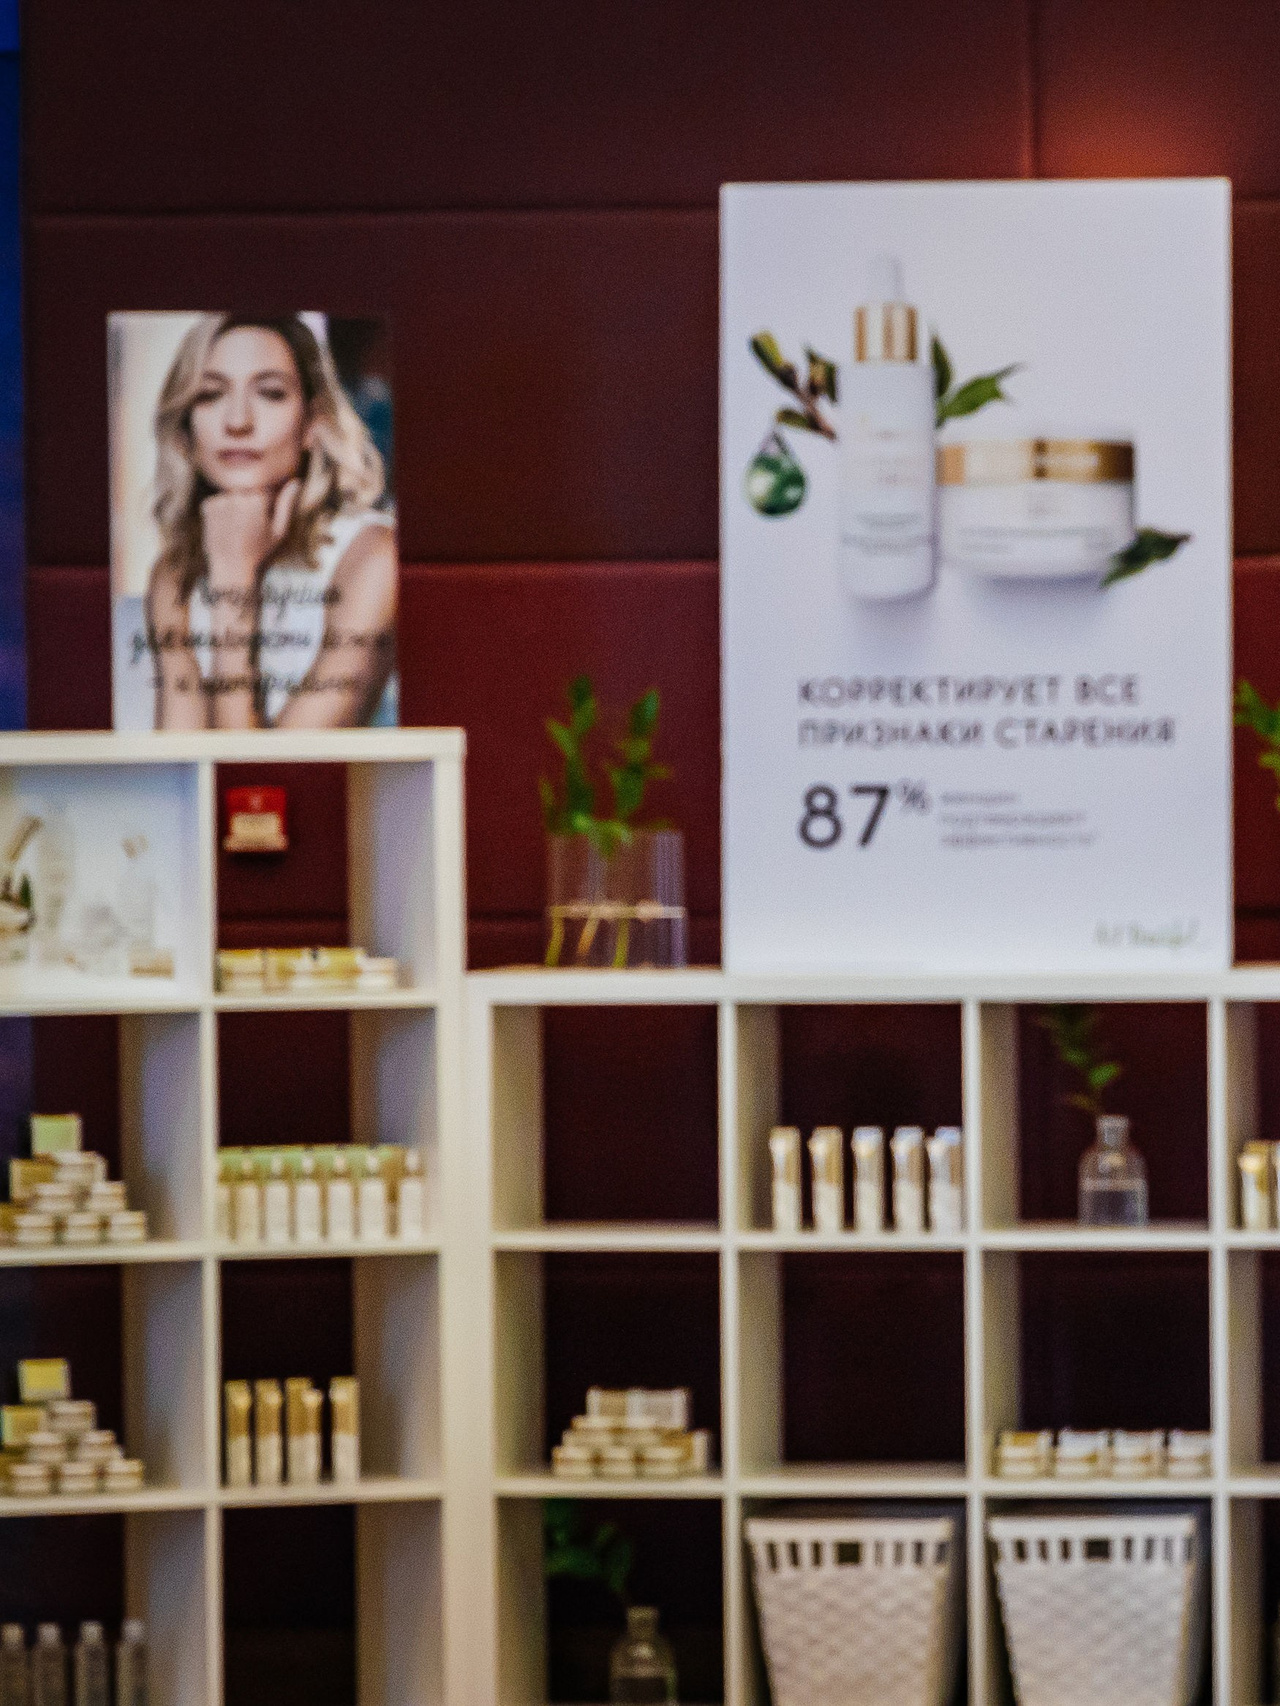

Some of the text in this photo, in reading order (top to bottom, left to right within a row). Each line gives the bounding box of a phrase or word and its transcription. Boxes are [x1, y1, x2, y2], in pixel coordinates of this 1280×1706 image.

[799, 674, 1138, 706] КОРРЕКТИРУЕТ ВСЕ
[799, 717, 1175, 748] ПРИЗНАКИ СТАРЕНИЯ
